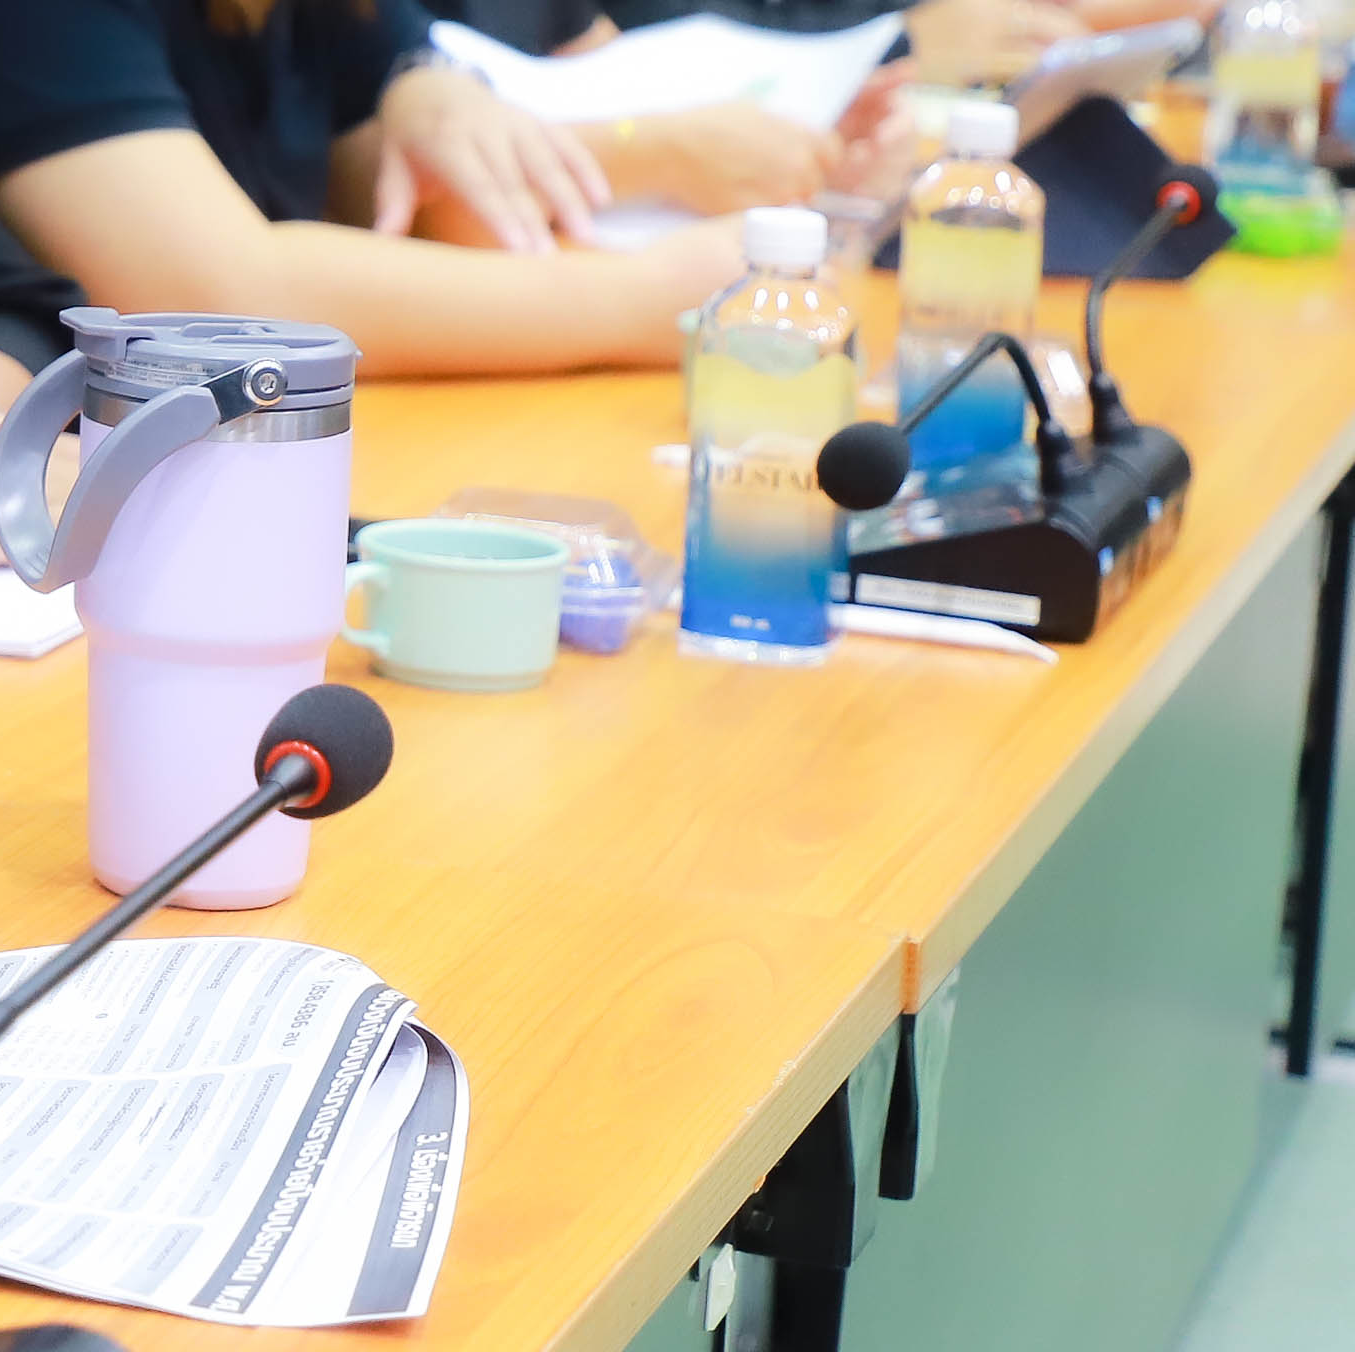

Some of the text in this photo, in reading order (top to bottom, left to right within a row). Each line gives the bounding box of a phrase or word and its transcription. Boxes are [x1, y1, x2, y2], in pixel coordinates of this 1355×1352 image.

[390, 1131, 450, 1249] 3. เรื่องเพื่อพิจารณา
